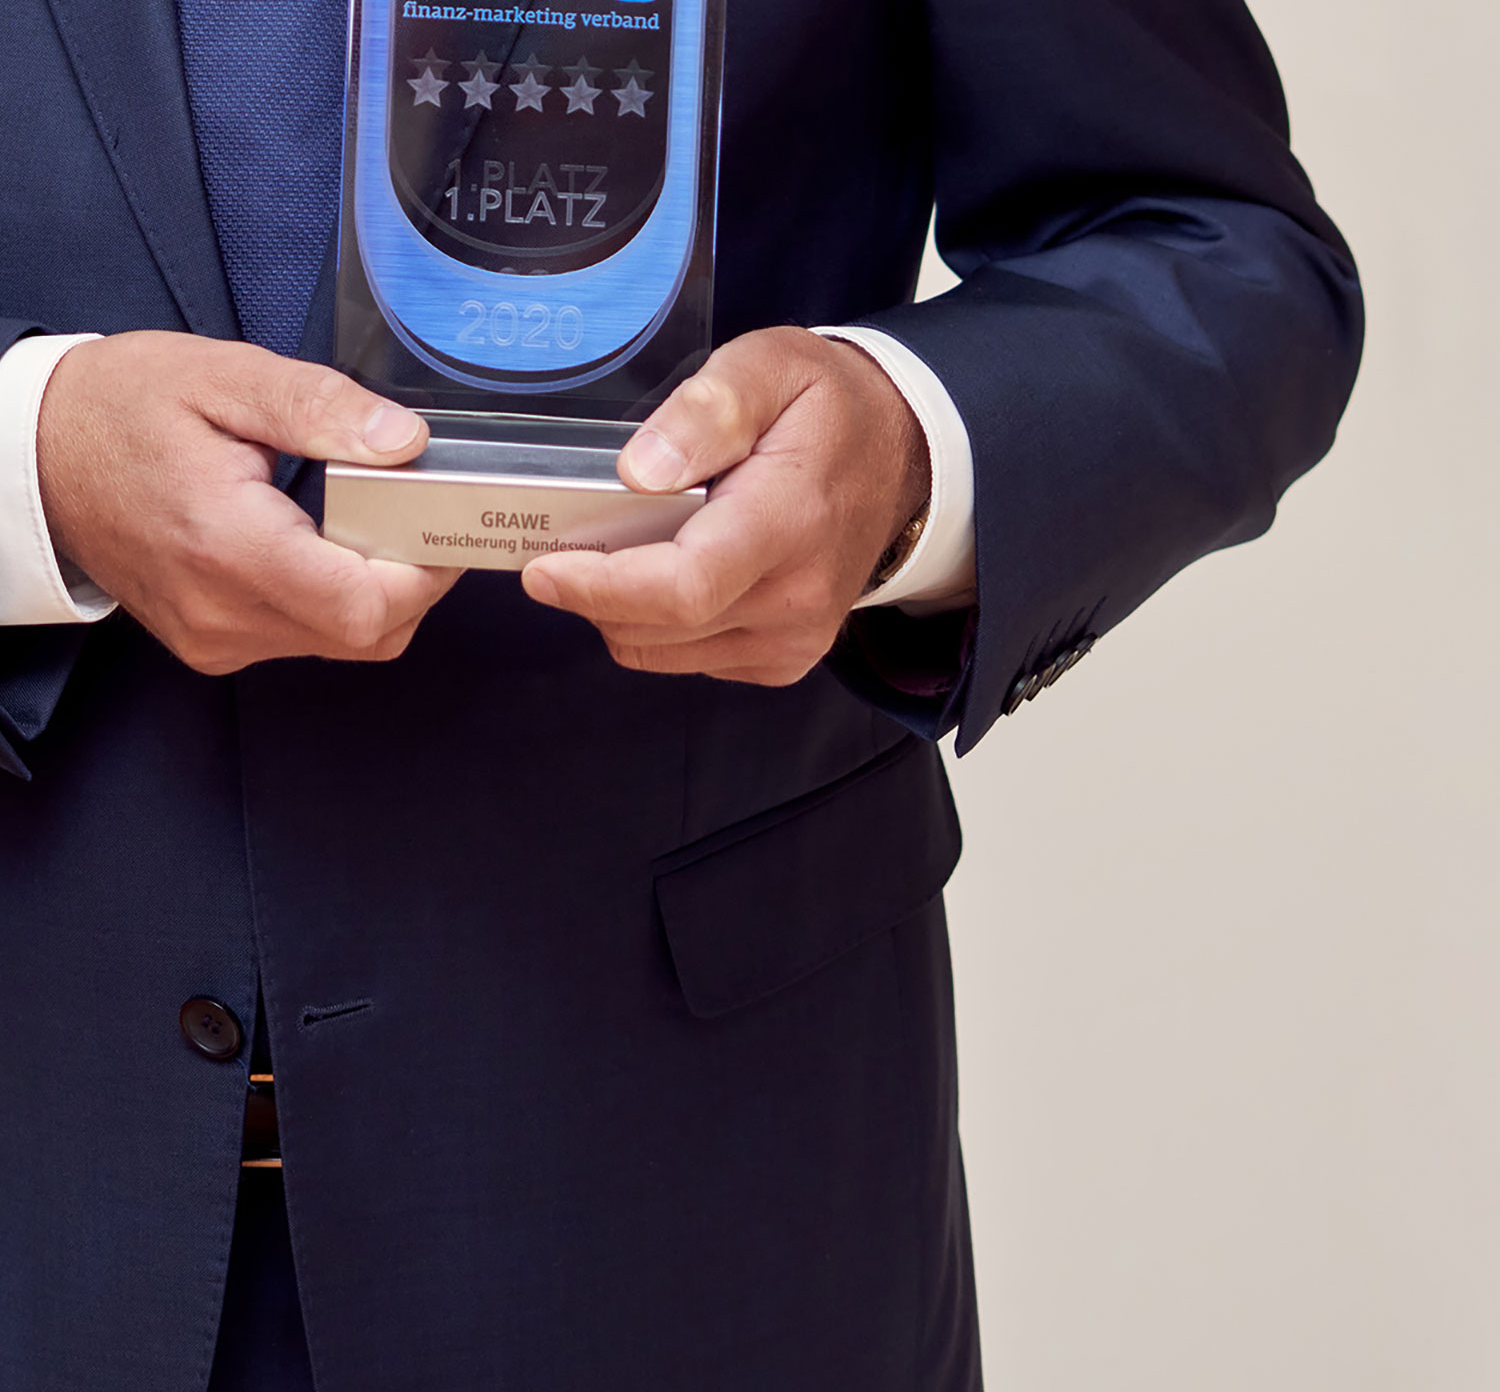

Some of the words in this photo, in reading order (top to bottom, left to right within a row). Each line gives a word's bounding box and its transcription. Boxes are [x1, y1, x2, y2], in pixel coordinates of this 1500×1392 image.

[402, 1, 576, 28] finanz-marketing
[581, 11, 660, 30] verband
[456, 300, 585, 350] 2020
[481, 511, 550, 531] GRAWE
[422, 531, 517, 554] Versicherung
